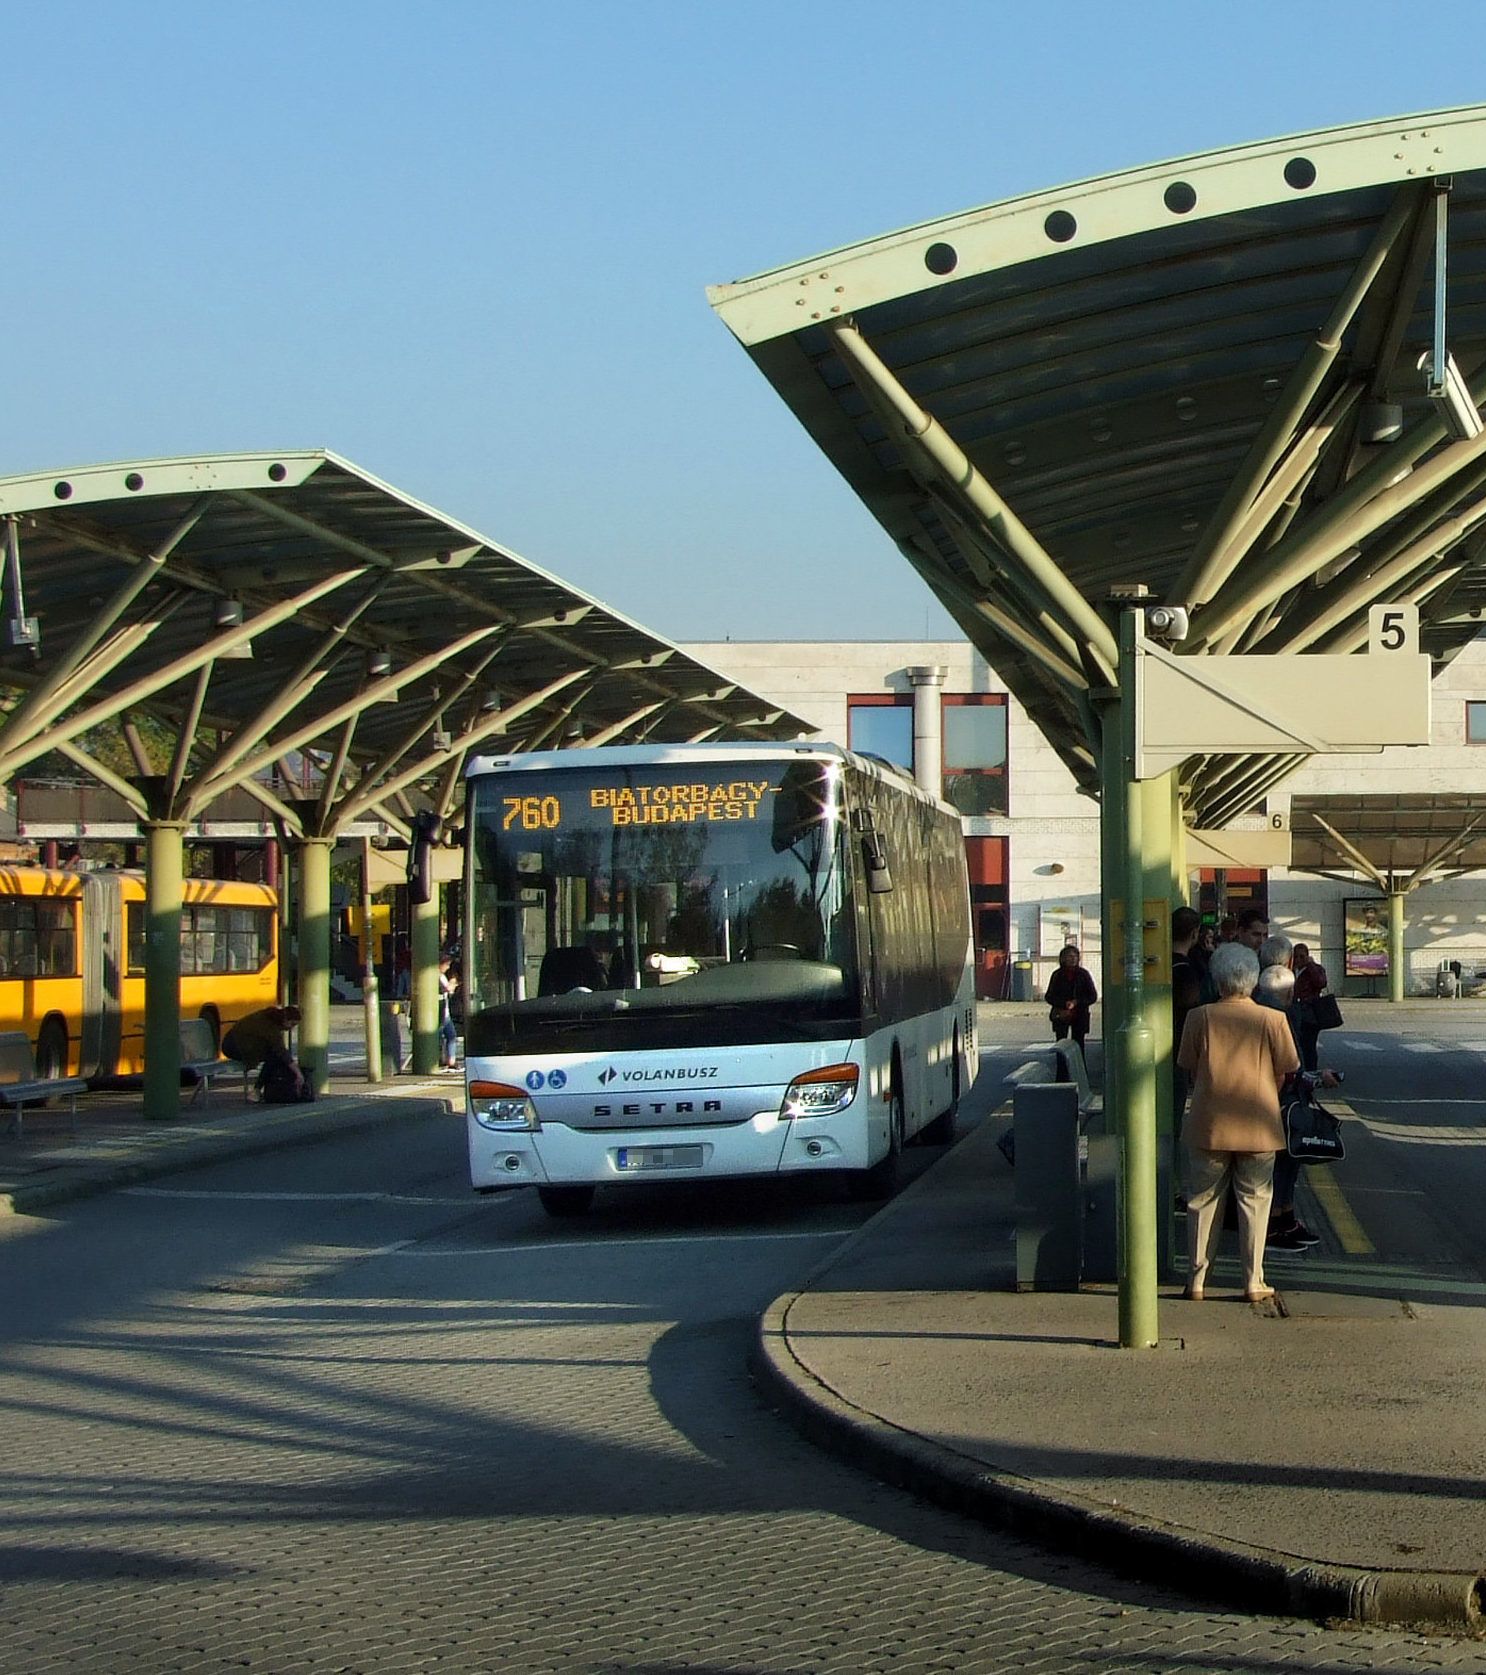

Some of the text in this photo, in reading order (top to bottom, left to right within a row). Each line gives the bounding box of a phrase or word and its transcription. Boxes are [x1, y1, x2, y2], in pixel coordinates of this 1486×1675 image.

[1380, 612, 1406, 650] 5
[590, 781, 783, 808] BIATORBÁGY-
[503, 795, 561, 831] 760
[612, 800, 759, 826] BUDAPEST
[1272, 813, 1283, 829] 6
[594, 1100, 722, 1117] SETRA
